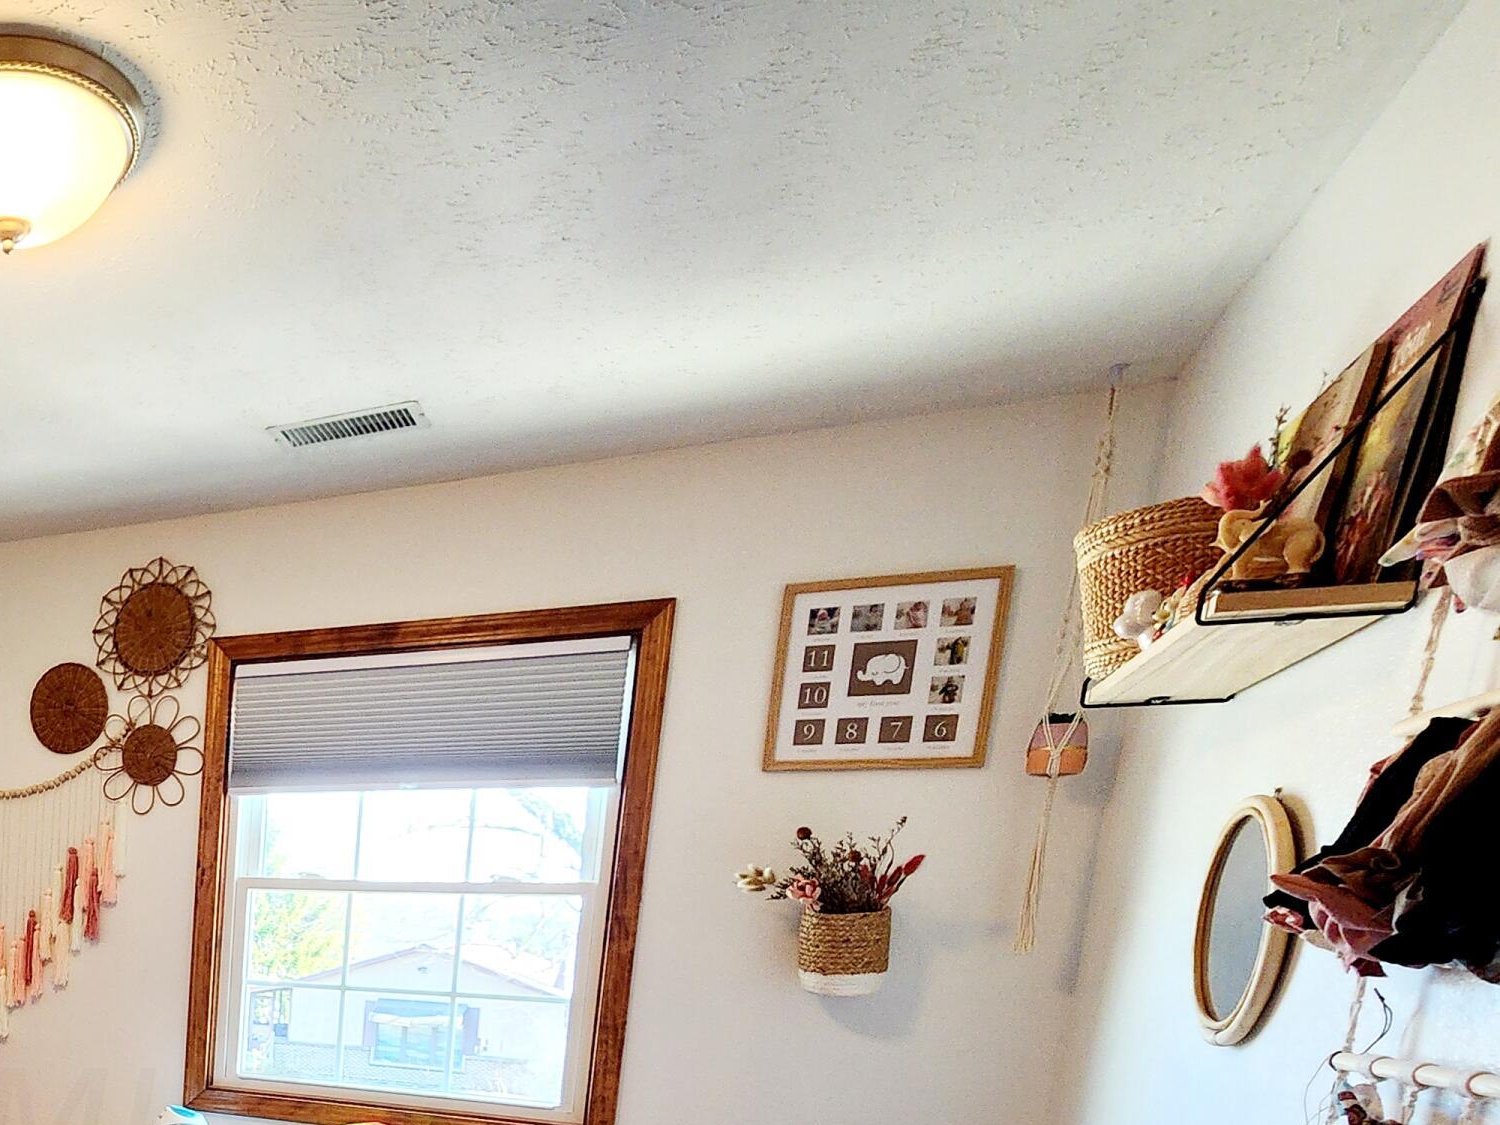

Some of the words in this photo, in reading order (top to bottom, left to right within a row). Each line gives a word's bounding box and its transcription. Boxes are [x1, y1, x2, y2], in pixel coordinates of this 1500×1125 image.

[809, 649, 829, 667] 11
[803, 687, 827, 704] 10
[803, 724, 815, 741] 9
[845, 722, 858, 740] 8
[891, 722, 903, 739] 7
[934, 720, 947, 738] 6
